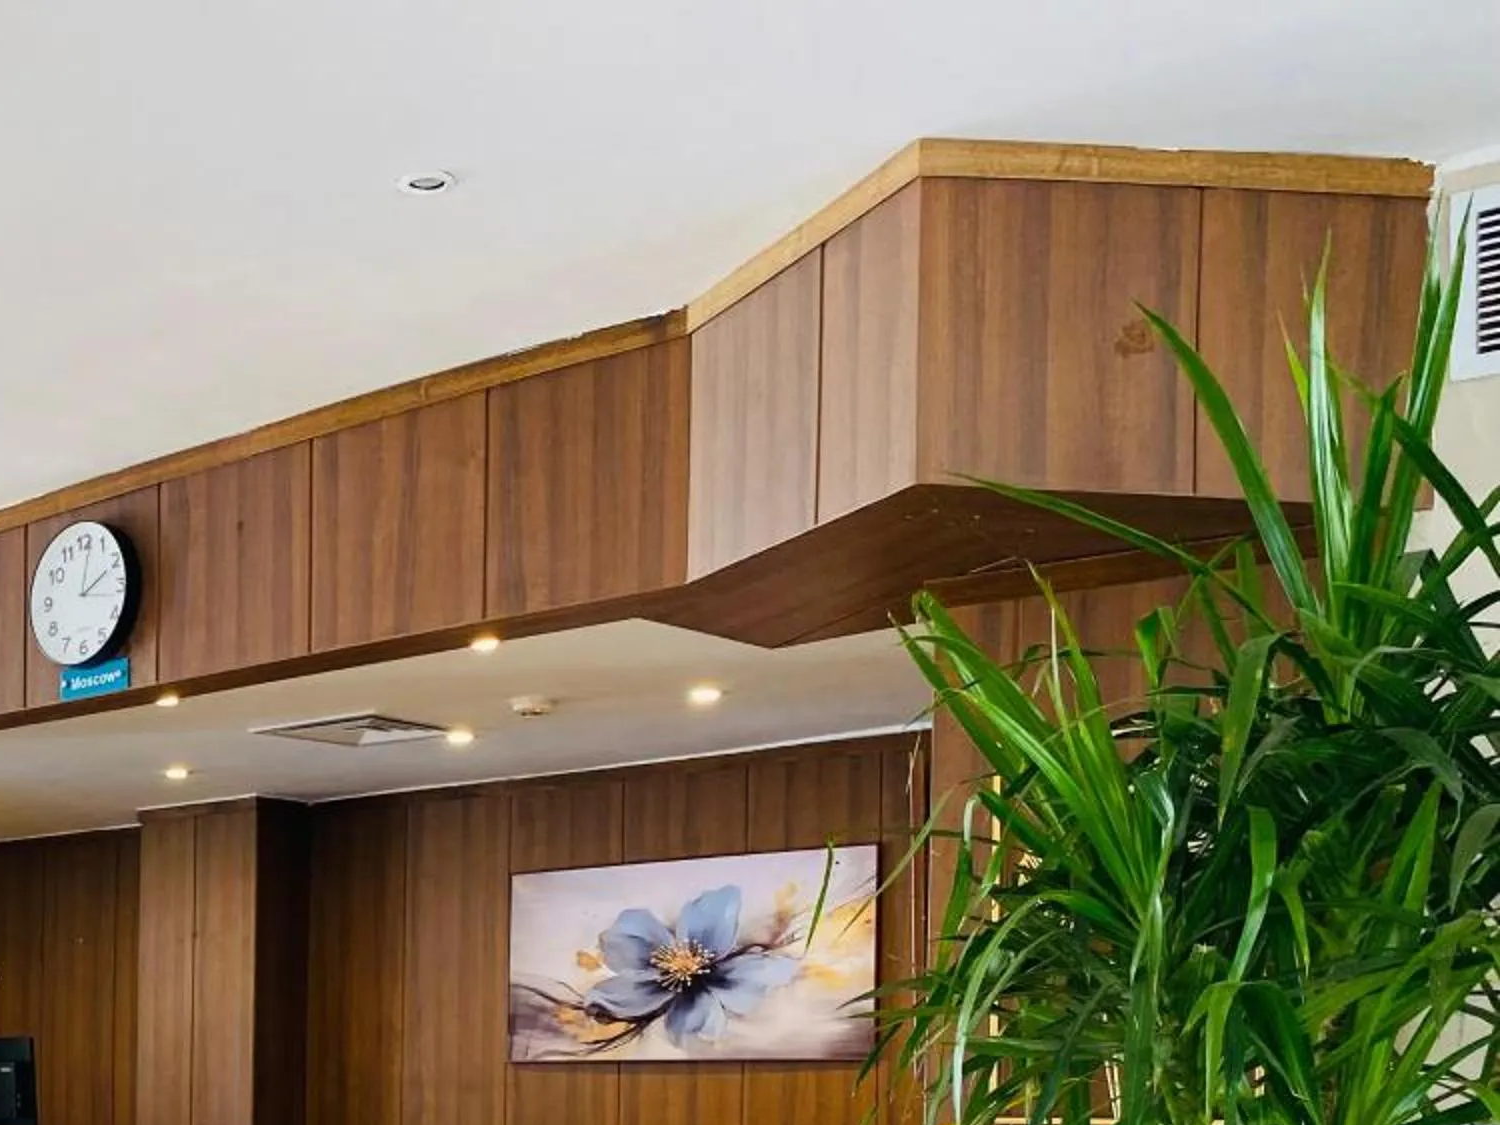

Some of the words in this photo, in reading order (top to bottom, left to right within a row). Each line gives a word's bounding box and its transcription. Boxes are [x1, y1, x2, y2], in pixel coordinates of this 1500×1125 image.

[77, 534, 92, 549] 12
[62, 546, 74, 563] 11
[111, 552, 120, 568] 2
[49, 567, 65, 586] 10
[116, 577, 124, 593] 3
[43, 597, 53, 613] 9
[110, 606, 119, 620] 4
[49, 621, 59, 637] 8
[98, 628, 108, 644] 5
[62, 637, 71, 654] 7
[79, 640, 89, 655] 6
[70, 672, 116, 690] Moscow
